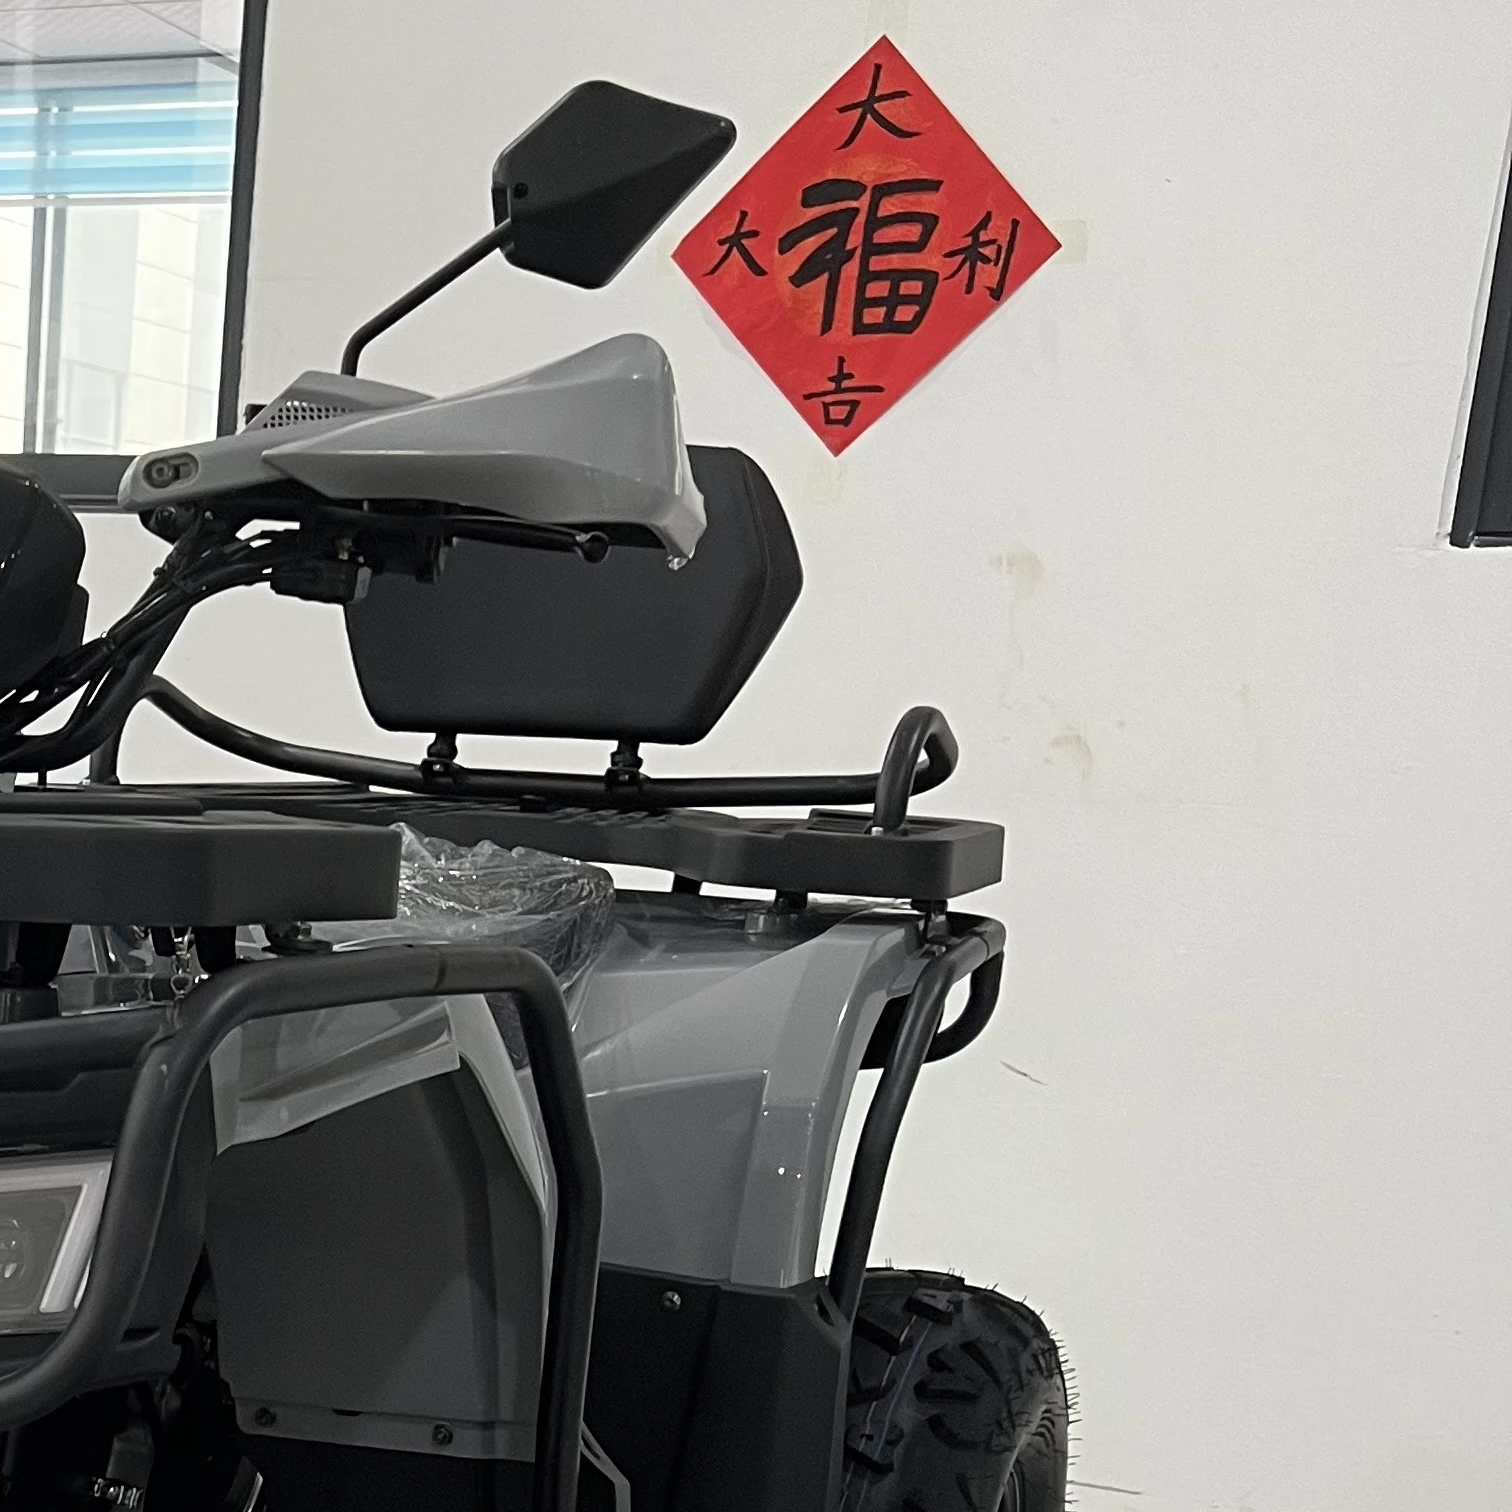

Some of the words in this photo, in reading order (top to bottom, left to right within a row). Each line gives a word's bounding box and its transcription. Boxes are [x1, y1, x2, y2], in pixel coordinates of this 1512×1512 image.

[834, 63, 924, 151] 大
[701, 210, 769, 277] 大
[778, 178, 945, 337] 福
[941, 211, 1021, 302] 利
[802, 355, 887, 428] 吉
